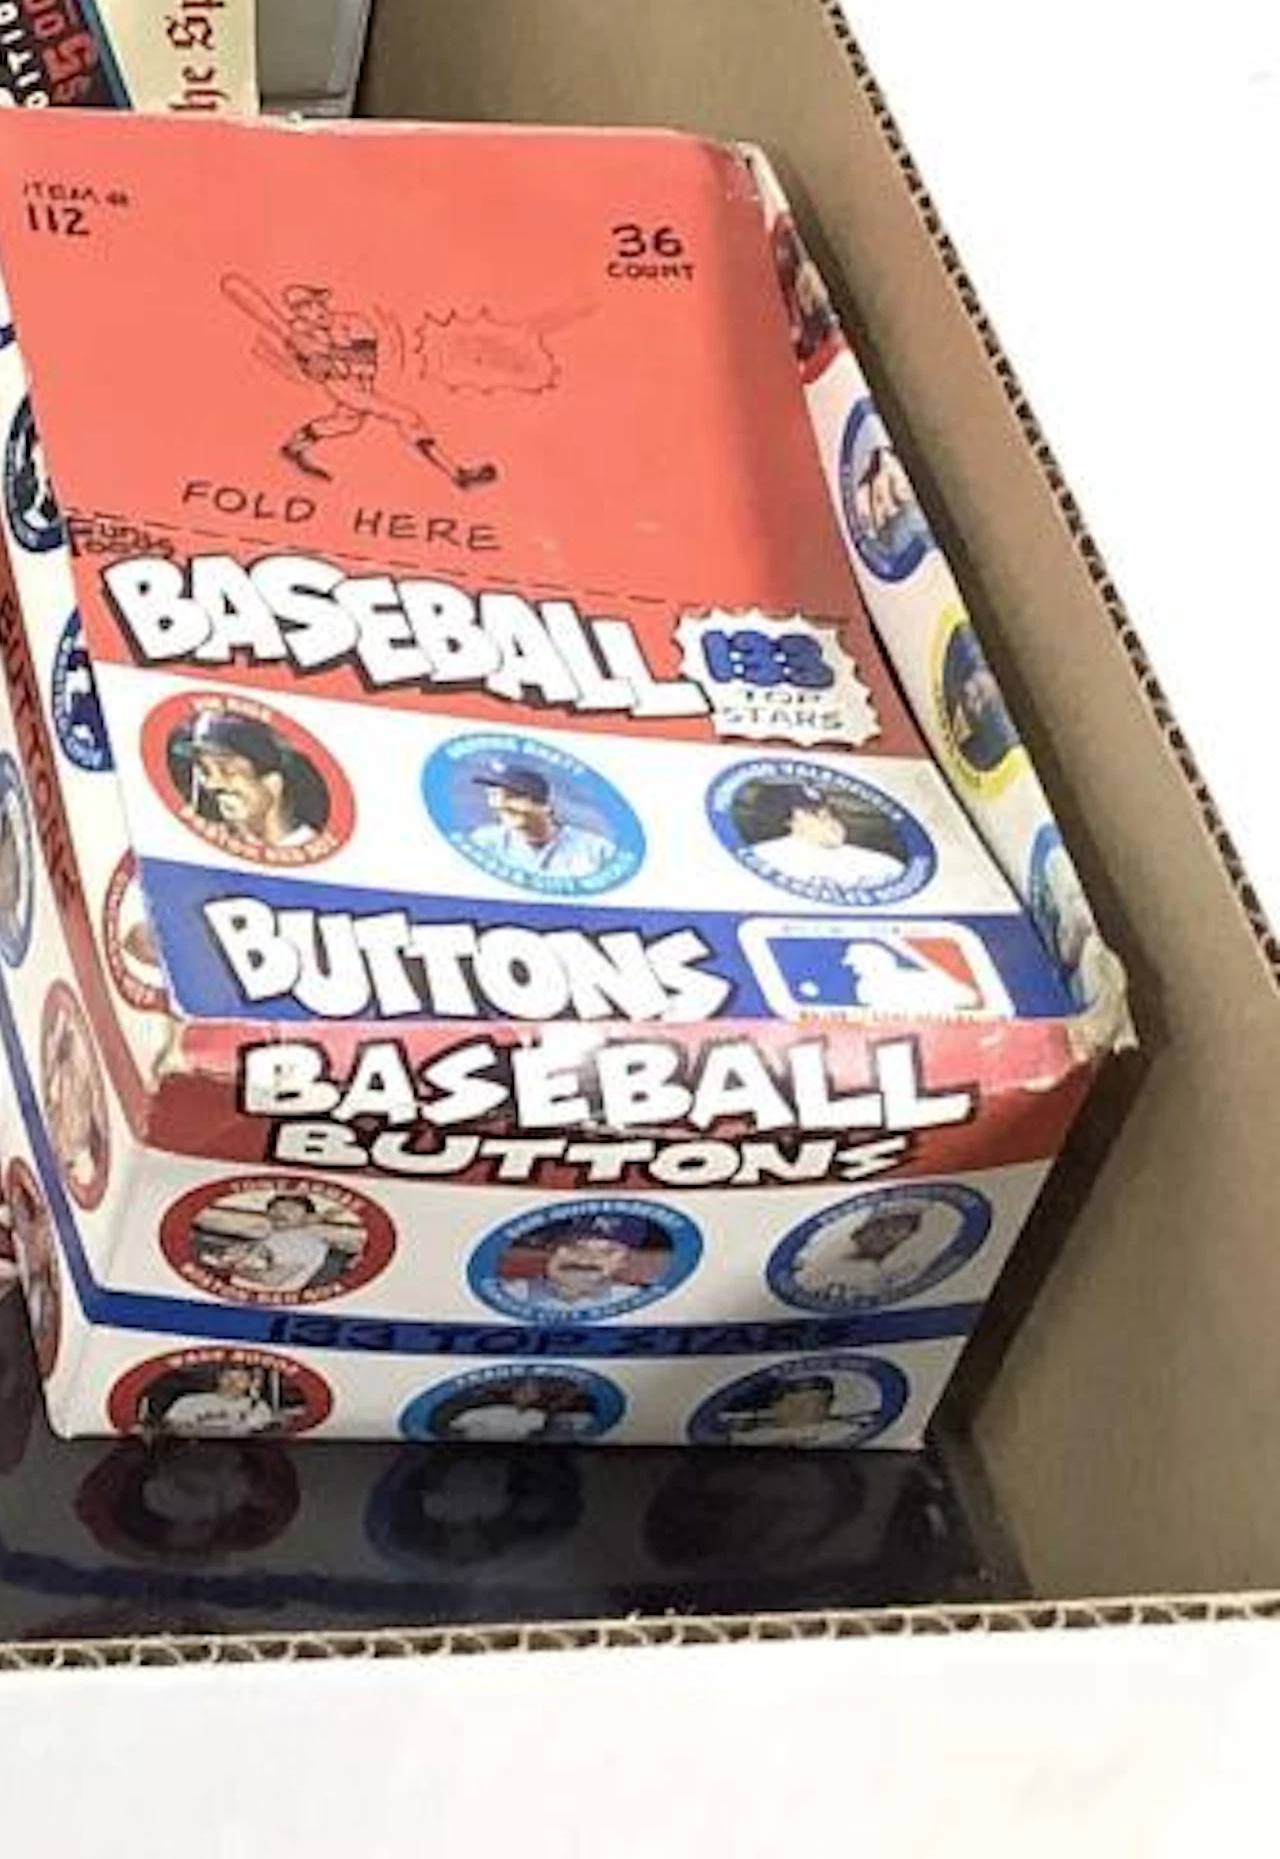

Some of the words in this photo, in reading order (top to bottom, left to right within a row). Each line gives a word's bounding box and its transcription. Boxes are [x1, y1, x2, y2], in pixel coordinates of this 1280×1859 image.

[169, 63, 230, 114] he
[23, 180, 101, 206] ITEM
[26, 205, 93, 238] 112
[611, 224, 685, 258] 36
[606, 260, 696, 281] COUNT
[181, 479, 318, 525] FOLD
[353, 506, 503, 553] HERE
[102, 550, 716, 720] BASEBALL
[722, 705, 845, 730] STARS
[745, 691, 822, 705] TOP
[203, 897, 740, 1022] BUTTONS
[243, 1036, 973, 1132] BASEBALL
[274, 1121, 908, 1188] BUTTONS
